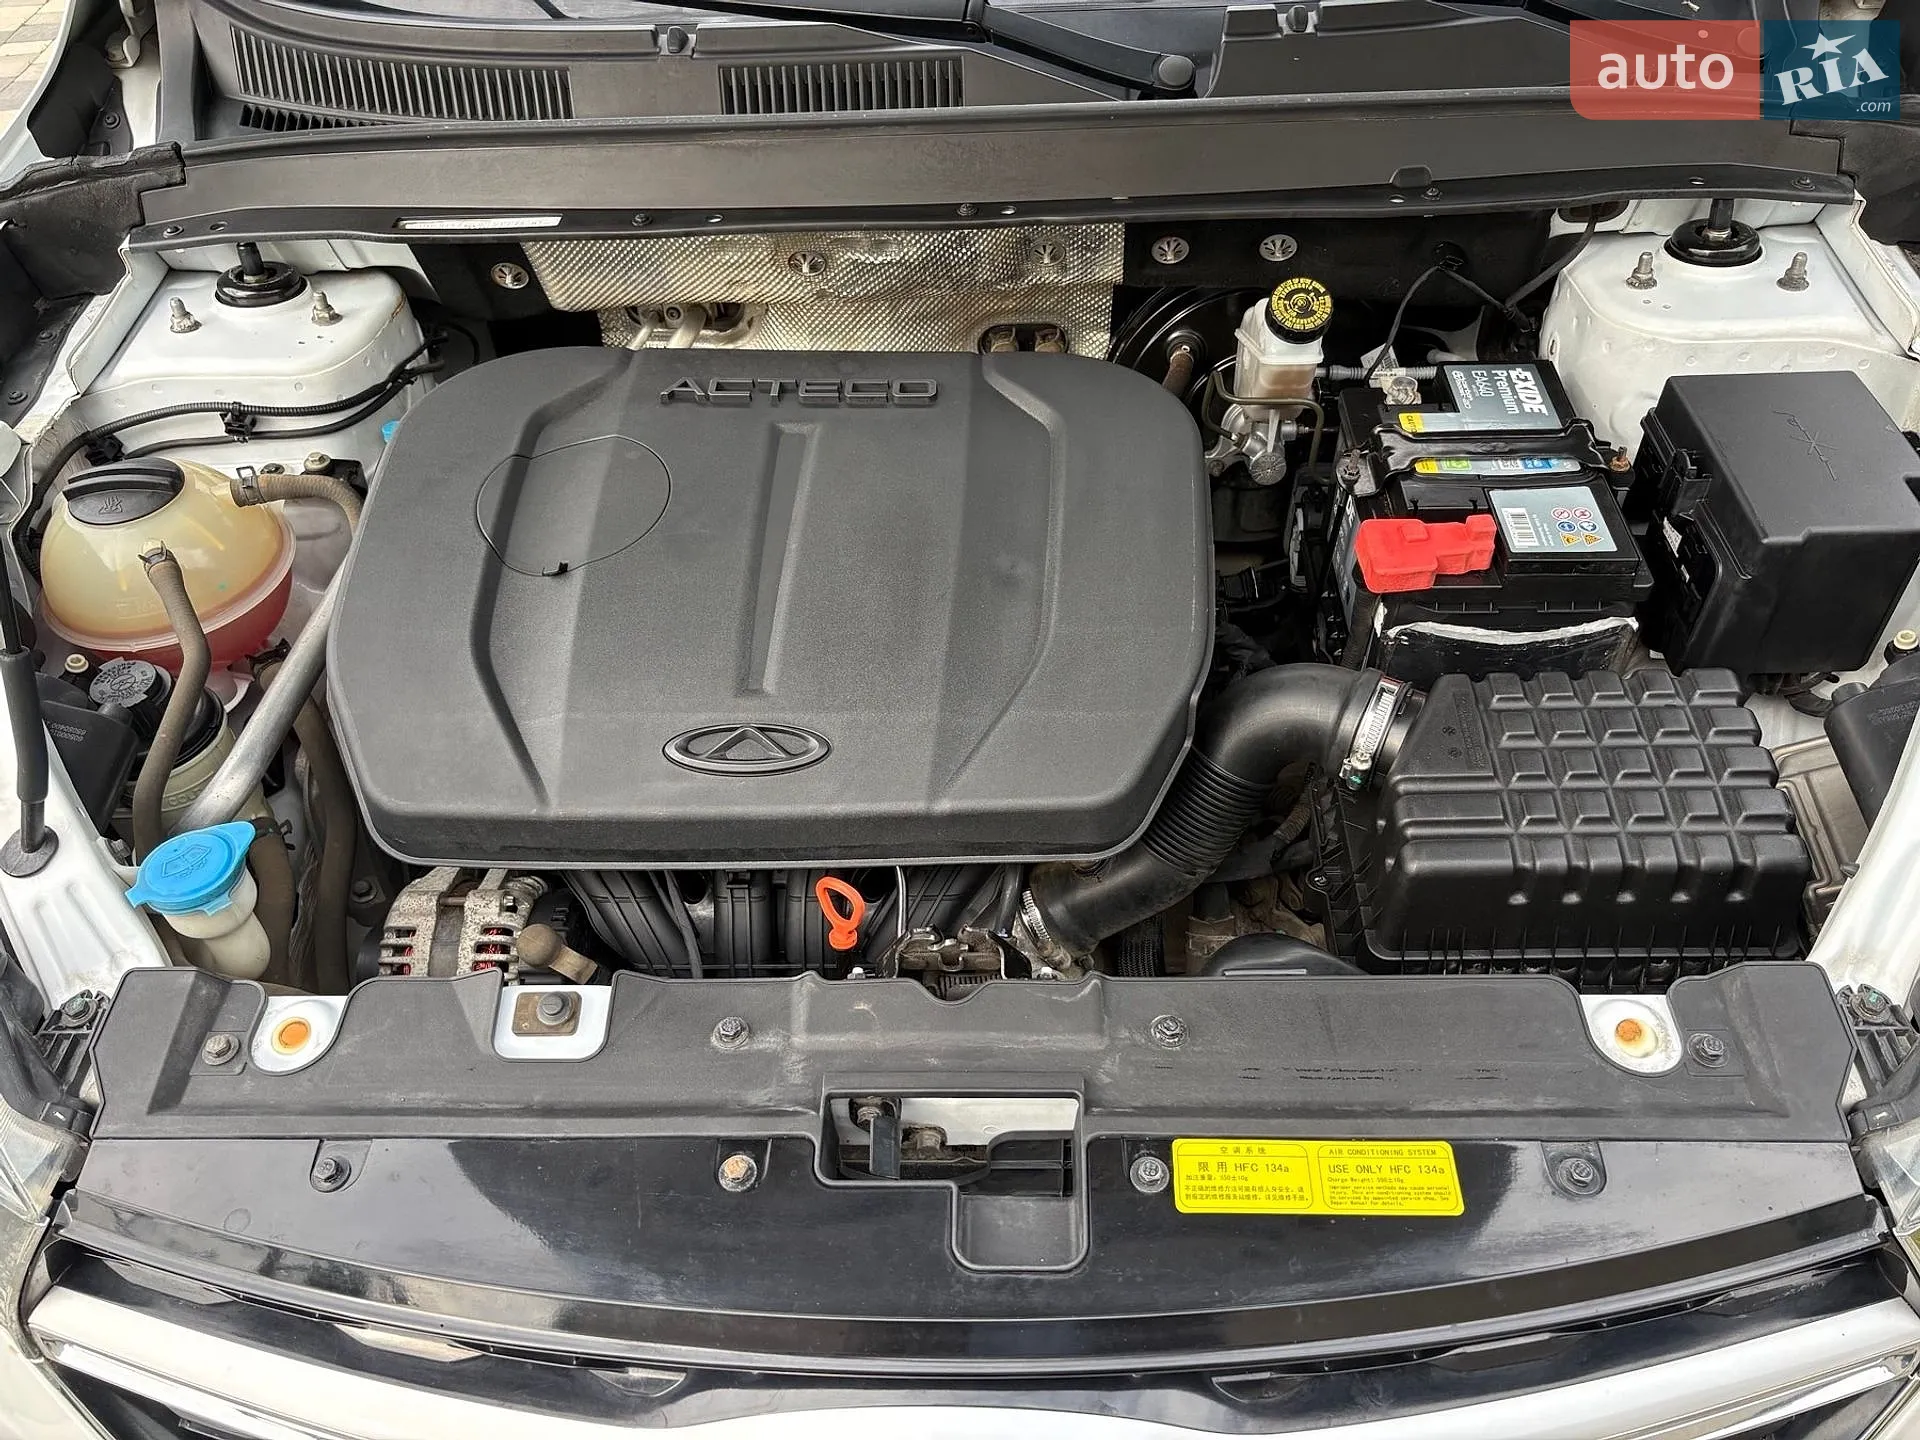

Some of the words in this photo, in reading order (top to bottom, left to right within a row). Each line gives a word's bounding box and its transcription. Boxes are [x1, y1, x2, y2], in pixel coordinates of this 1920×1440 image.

[659, 376, 938, 406] ACTECO
[1471, 370, 1495, 397] EA640
[1491, 370, 1520, 414] Premium
[1508, 367, 1549, 416] EXIDE
[1234, 1163, 1259, 1173] HFC
[1265, 1163, 1290, 1173] 134a
[1328, 1164, 1350, 1174] USE
[1355, 1164, 1383, 1174] ONLY
[1389, 1164, 1412, 1174] HFC
[1418, 1164, 1446, 1174] 134a
